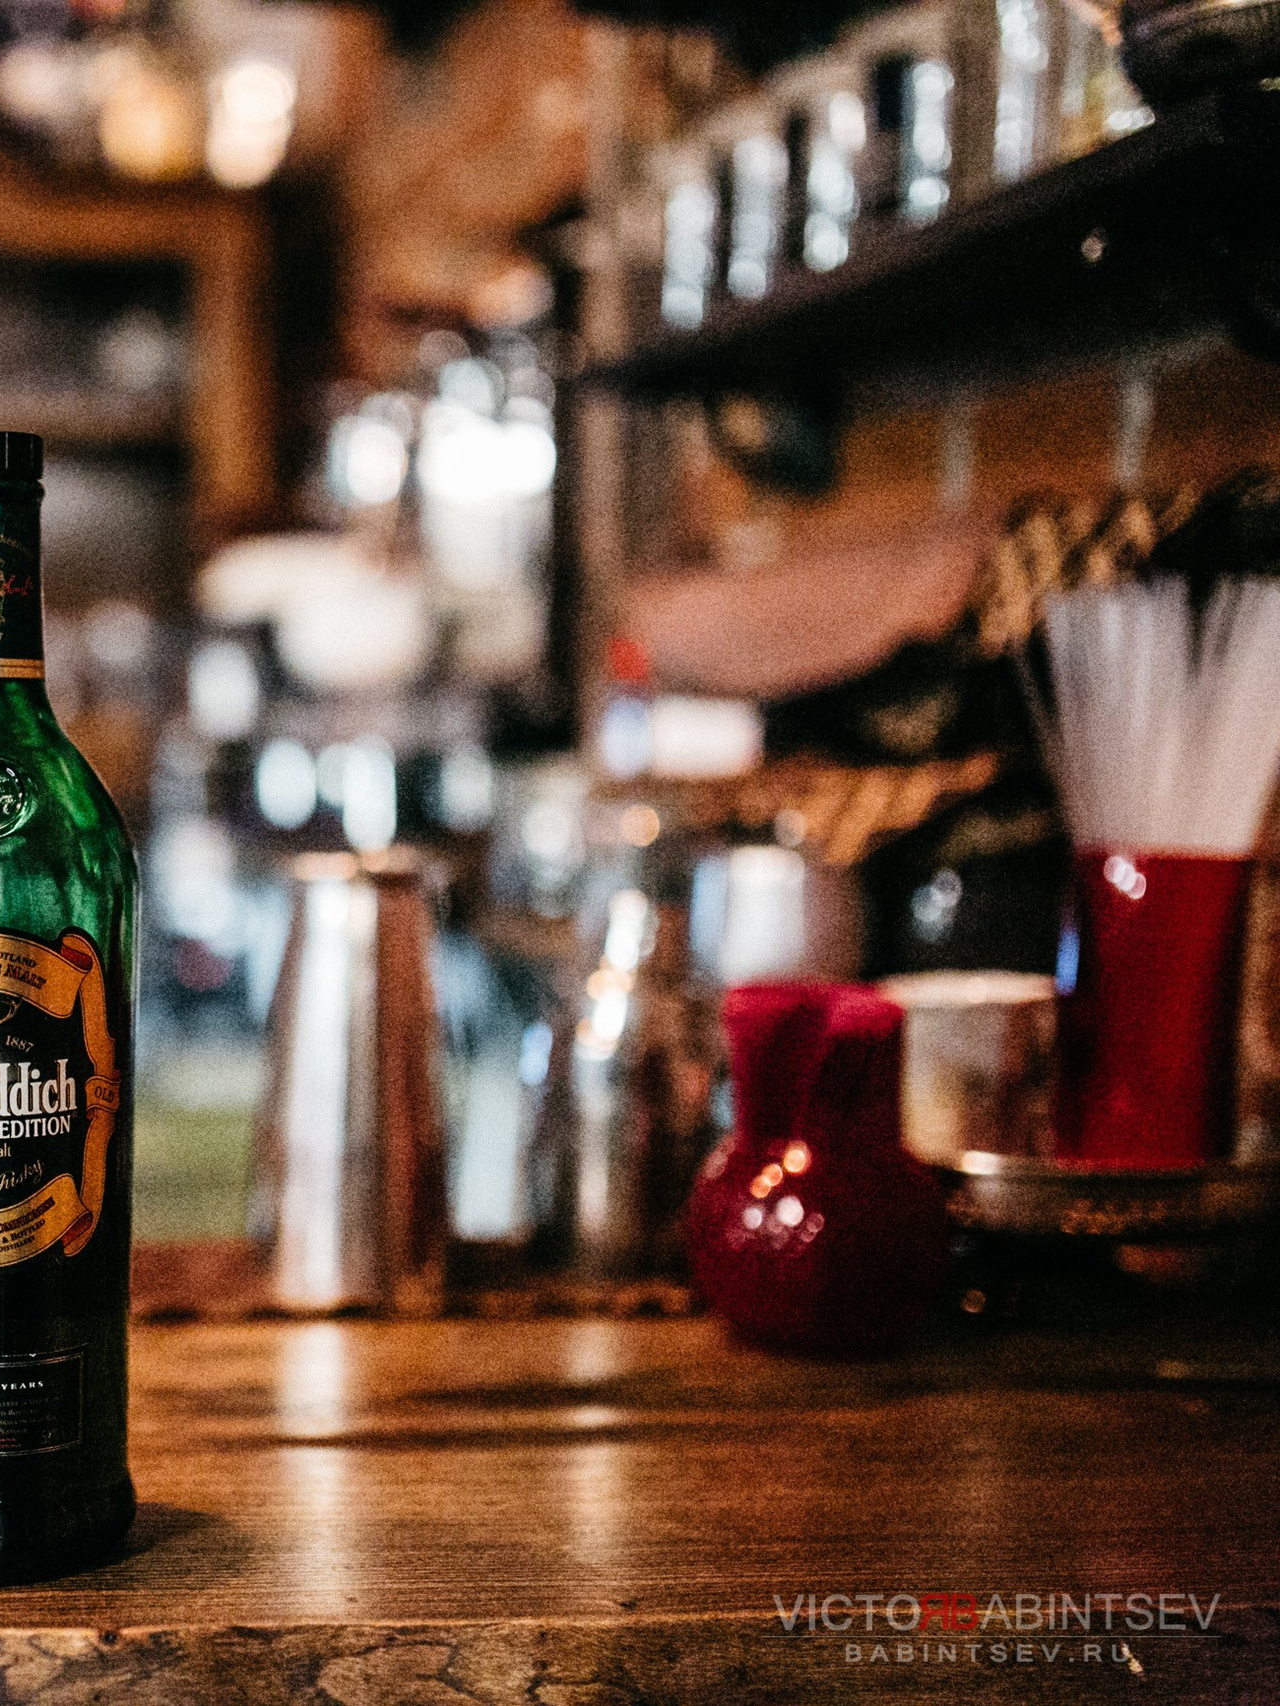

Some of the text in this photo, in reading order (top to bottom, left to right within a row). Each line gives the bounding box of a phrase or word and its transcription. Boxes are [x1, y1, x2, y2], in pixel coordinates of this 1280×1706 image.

[5, 964, 46, 990] MALT
[5, 1035, 35, 1052] 1887
[94, 1085, 115, 1103] OLD
[0, 1115, 70, 1139] EDITION
[1, 1380, 44, 1391] YEARS
